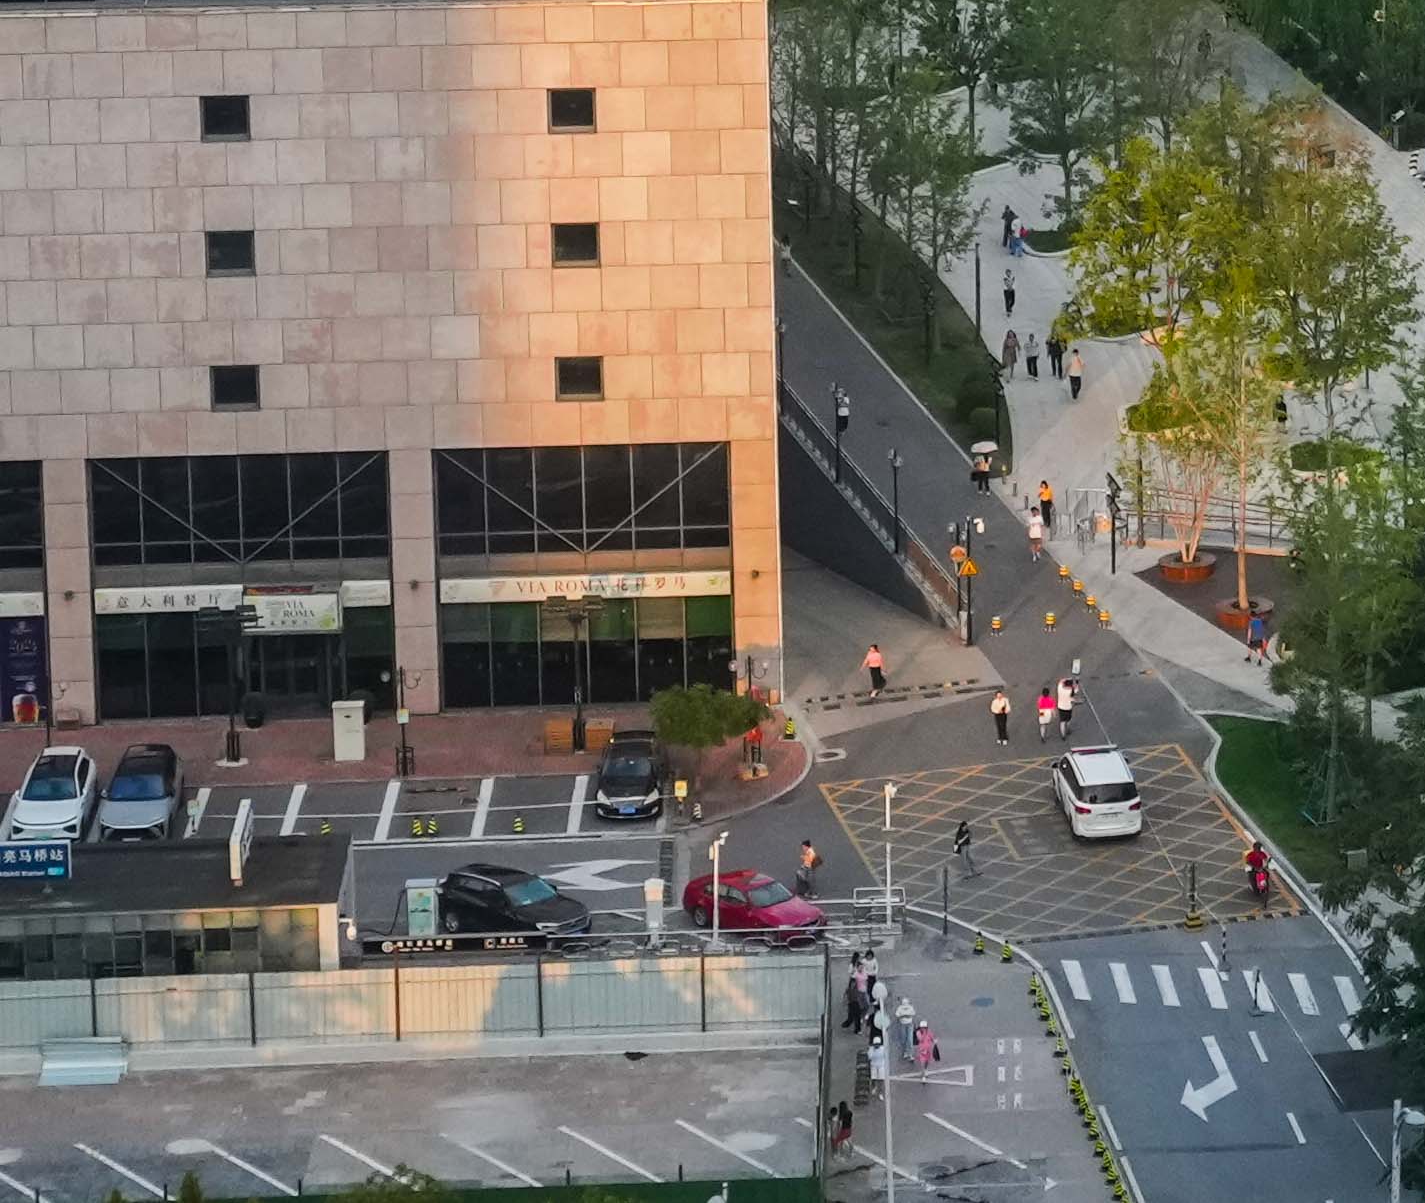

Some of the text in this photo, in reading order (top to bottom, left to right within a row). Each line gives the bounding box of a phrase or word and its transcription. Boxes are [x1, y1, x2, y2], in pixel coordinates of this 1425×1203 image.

[516, 580, 547, 593] VIA
[554, 579, 606, 593] ROMA
[117, 593, 219, 609] 意大利餐厅
[286, 600, 304, 609] VIA
[283, 609, 315, 618] ROMA
